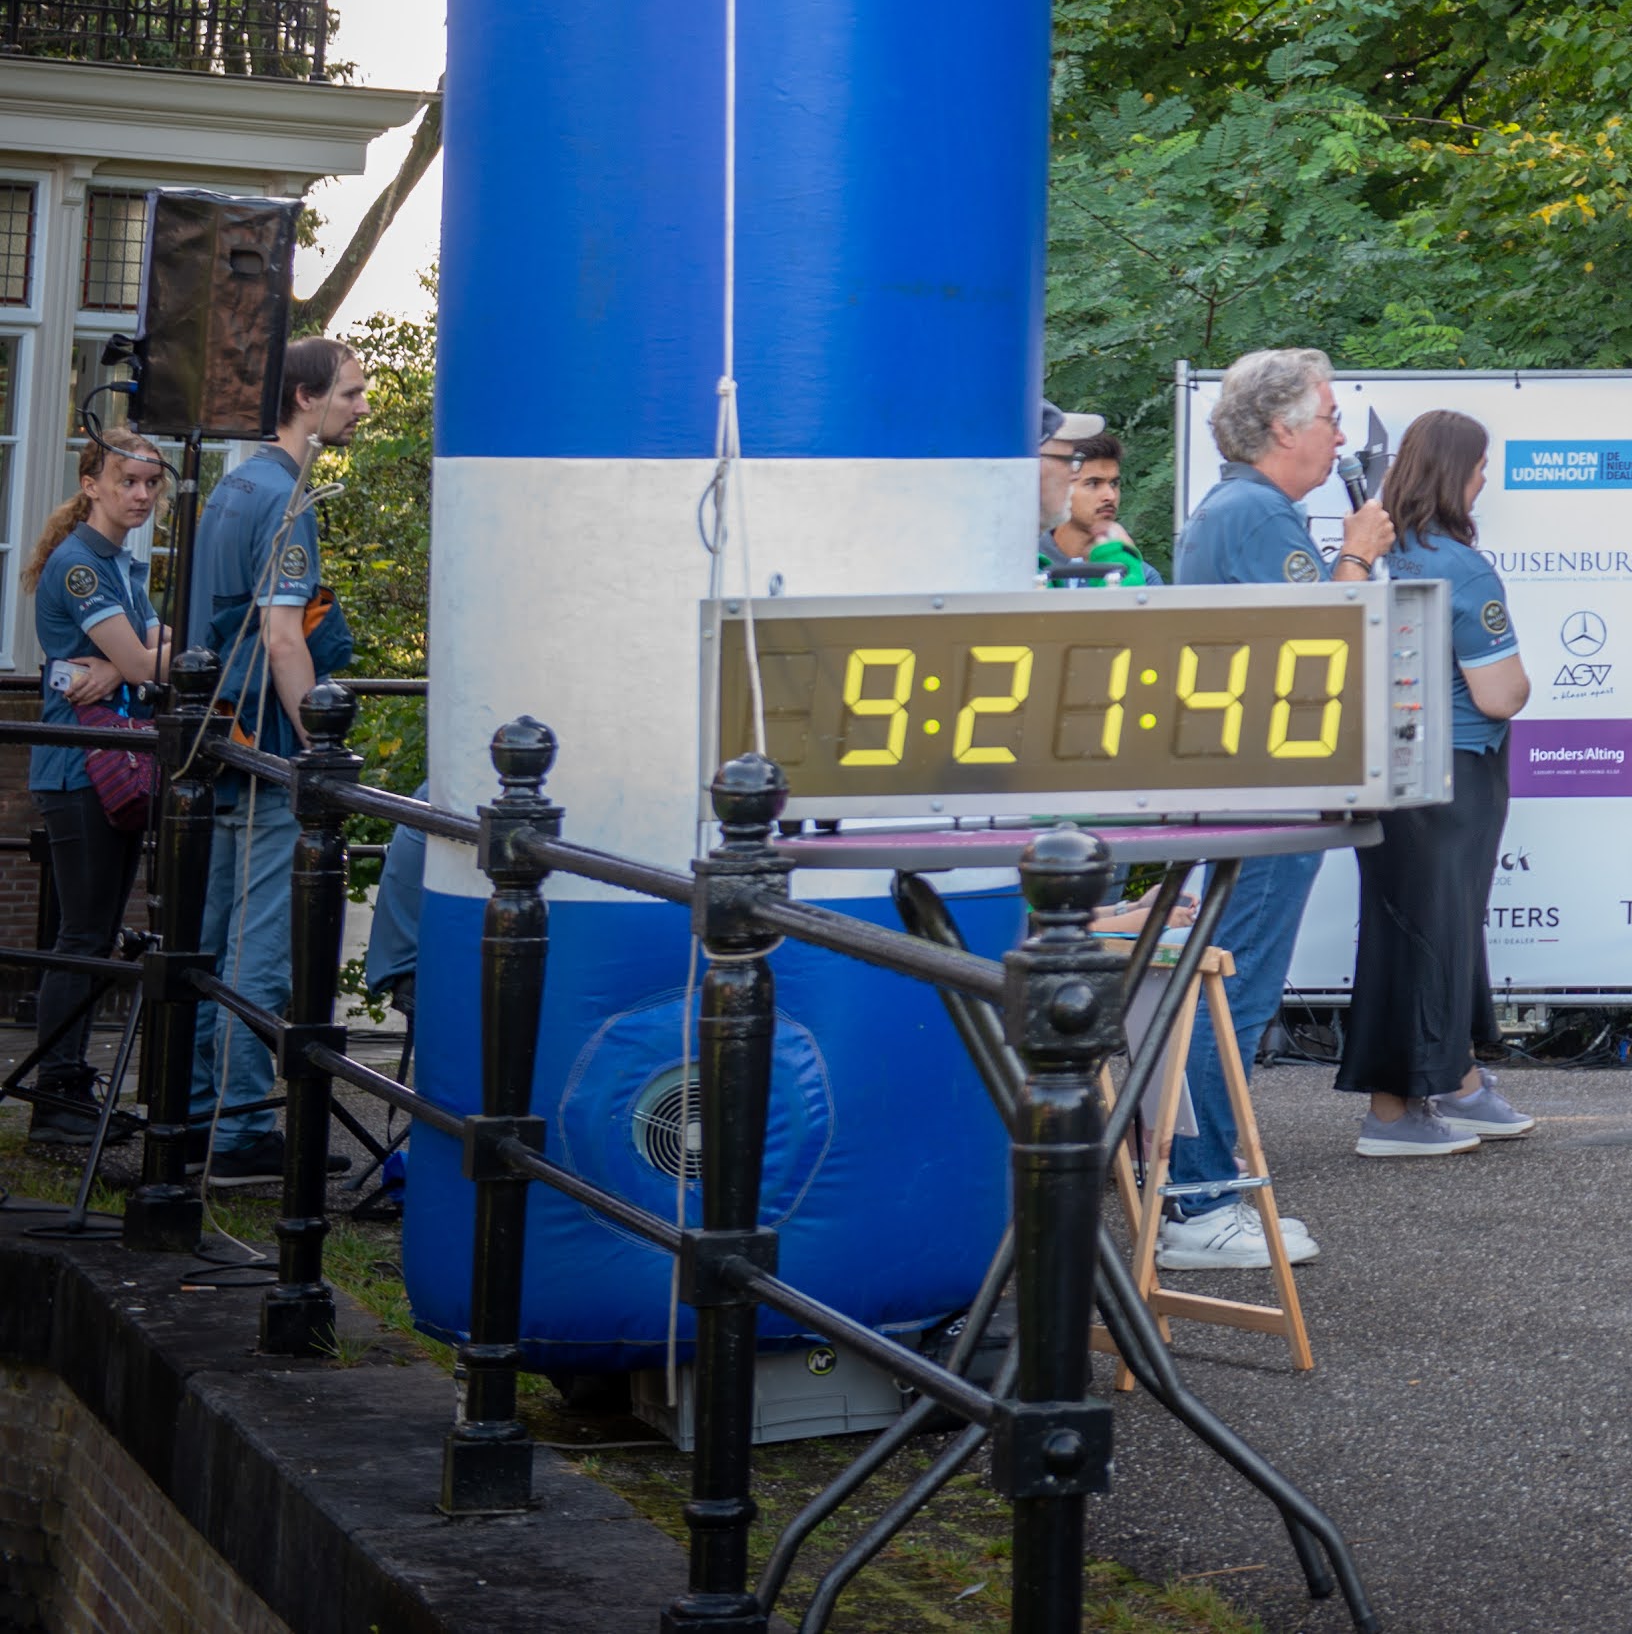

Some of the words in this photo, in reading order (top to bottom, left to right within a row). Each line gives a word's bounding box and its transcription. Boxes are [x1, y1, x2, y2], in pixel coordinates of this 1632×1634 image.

[1532, 452, 1564, 465] VAN
[1567, 452, 1598, 465] DEN
[1606, 451, 1620, 461] DE
[1512, 467, 1598, 482] UDENHOUT
[839, 639, 1350, 766] 9:21:40
[1484, 907, 1560, 928] TERS
